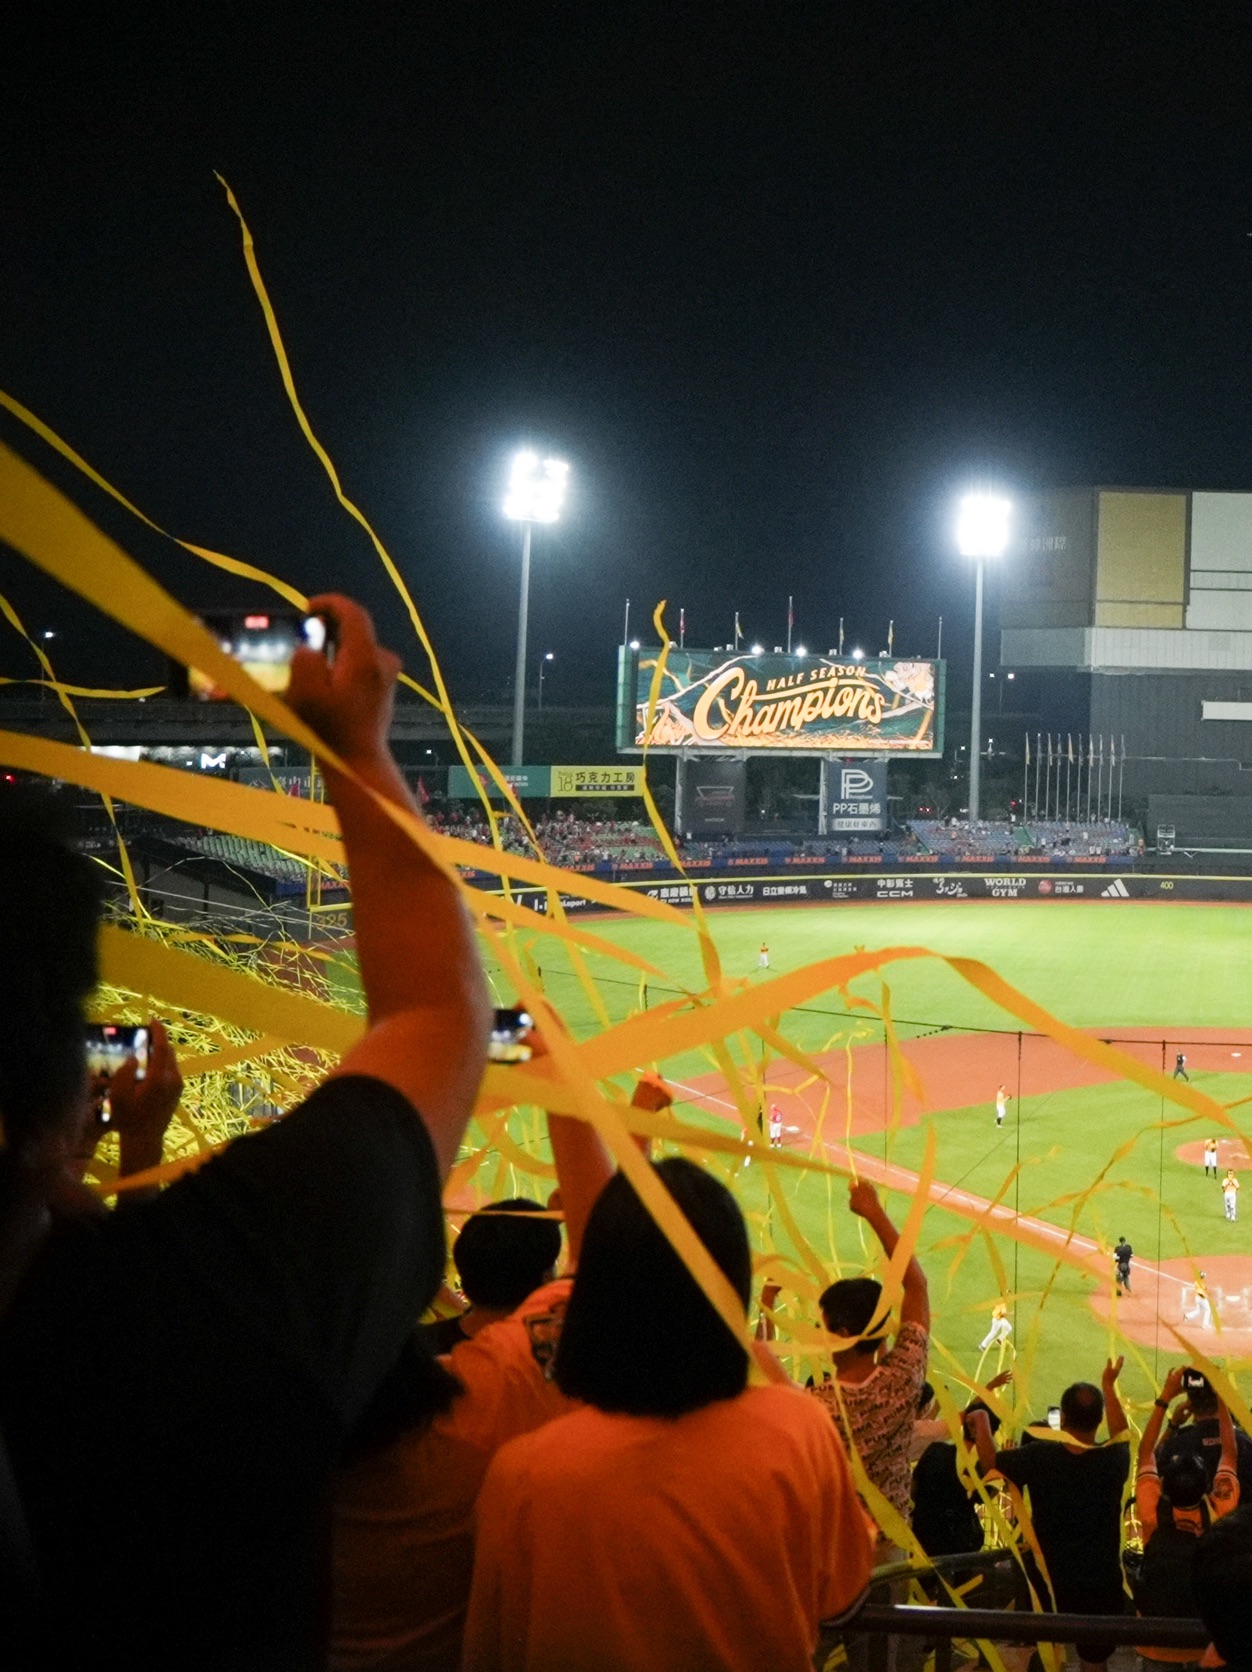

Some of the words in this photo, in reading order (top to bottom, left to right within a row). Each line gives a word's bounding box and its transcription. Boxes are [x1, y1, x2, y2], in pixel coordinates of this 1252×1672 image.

[766, 673, 804, 691] HALF
[810, 666, 867, 680] SEASON
[693, 667, 885, 740] Champions
[575, 771, 635, 783] 巧克力工房
[832, 803, 881, 814] PP石墨烯
[735, 857, 768, 865] MAXXIS
[619, 862, 653, 870] MAXXIS
[984, 878, 1026, 886] WORLD
[1160, 881, 1174, 890] 400
[718, 885, 754, 895] 守信人力
[992, 888, 1018, 897] GYM
